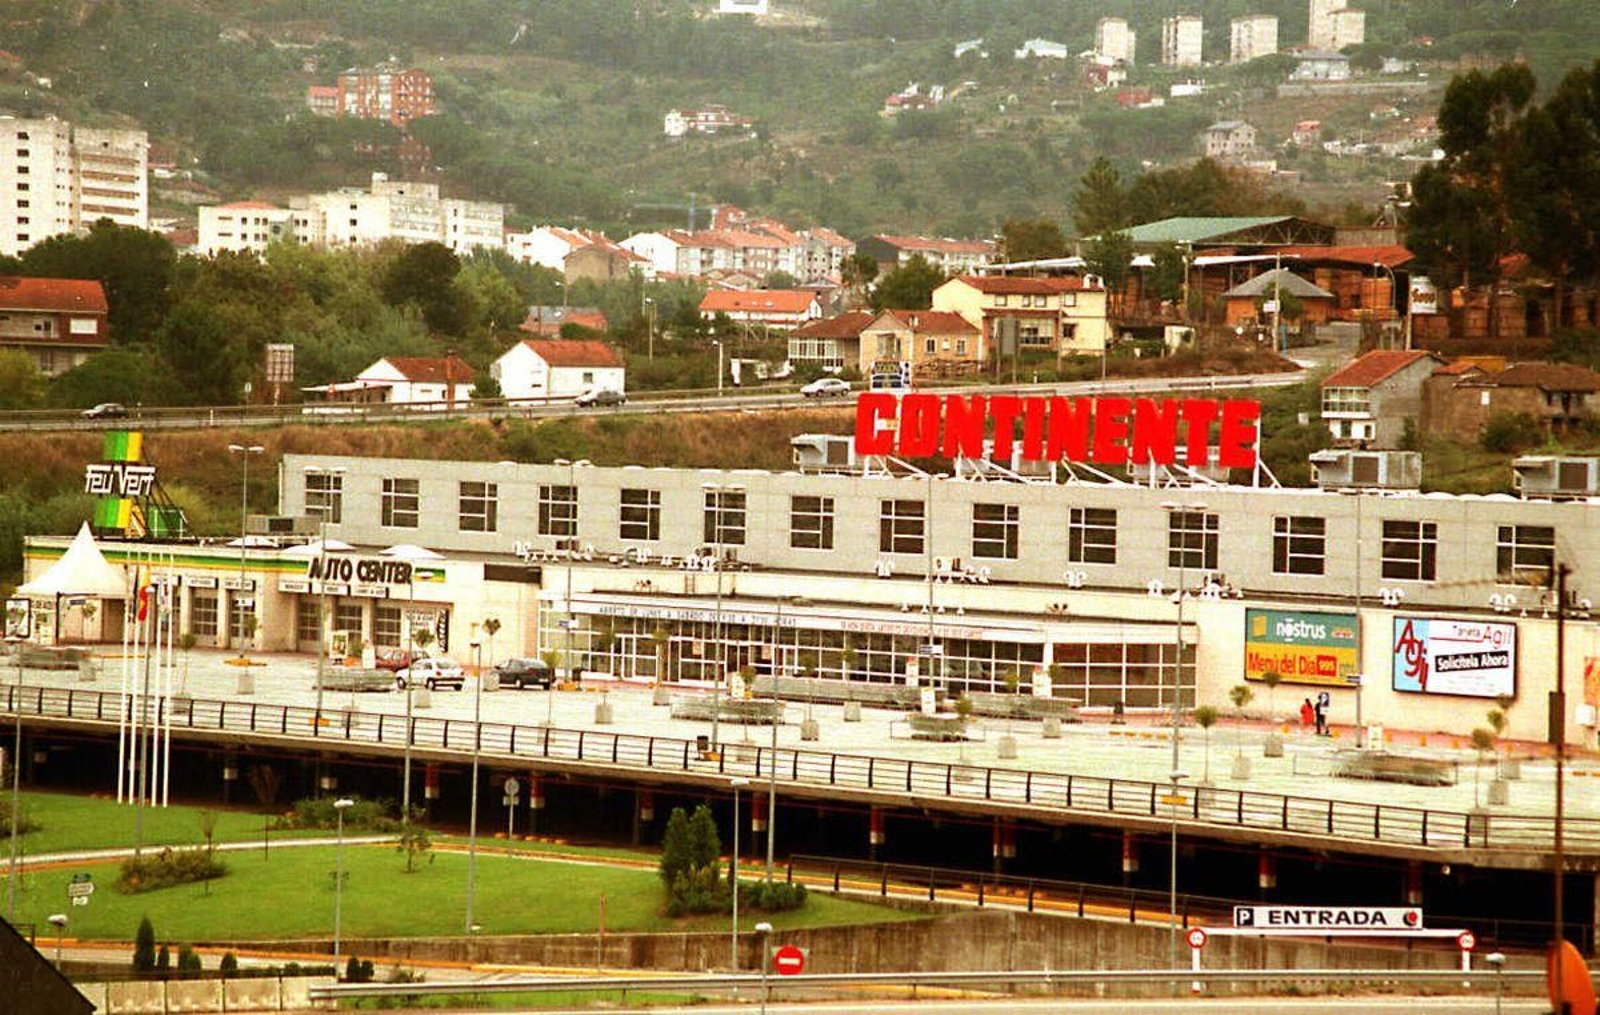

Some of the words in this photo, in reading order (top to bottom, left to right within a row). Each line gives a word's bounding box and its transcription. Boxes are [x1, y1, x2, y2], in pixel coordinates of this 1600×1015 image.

[855, 393, 1261, 469] CONTINENTE
[356, 560, 413, 585] CENTER
[1280, 654, 1297, 673] del
[1481, 653, 1508, 668] Ahora
[1268, 910, 1388, 926] ENTRADA
